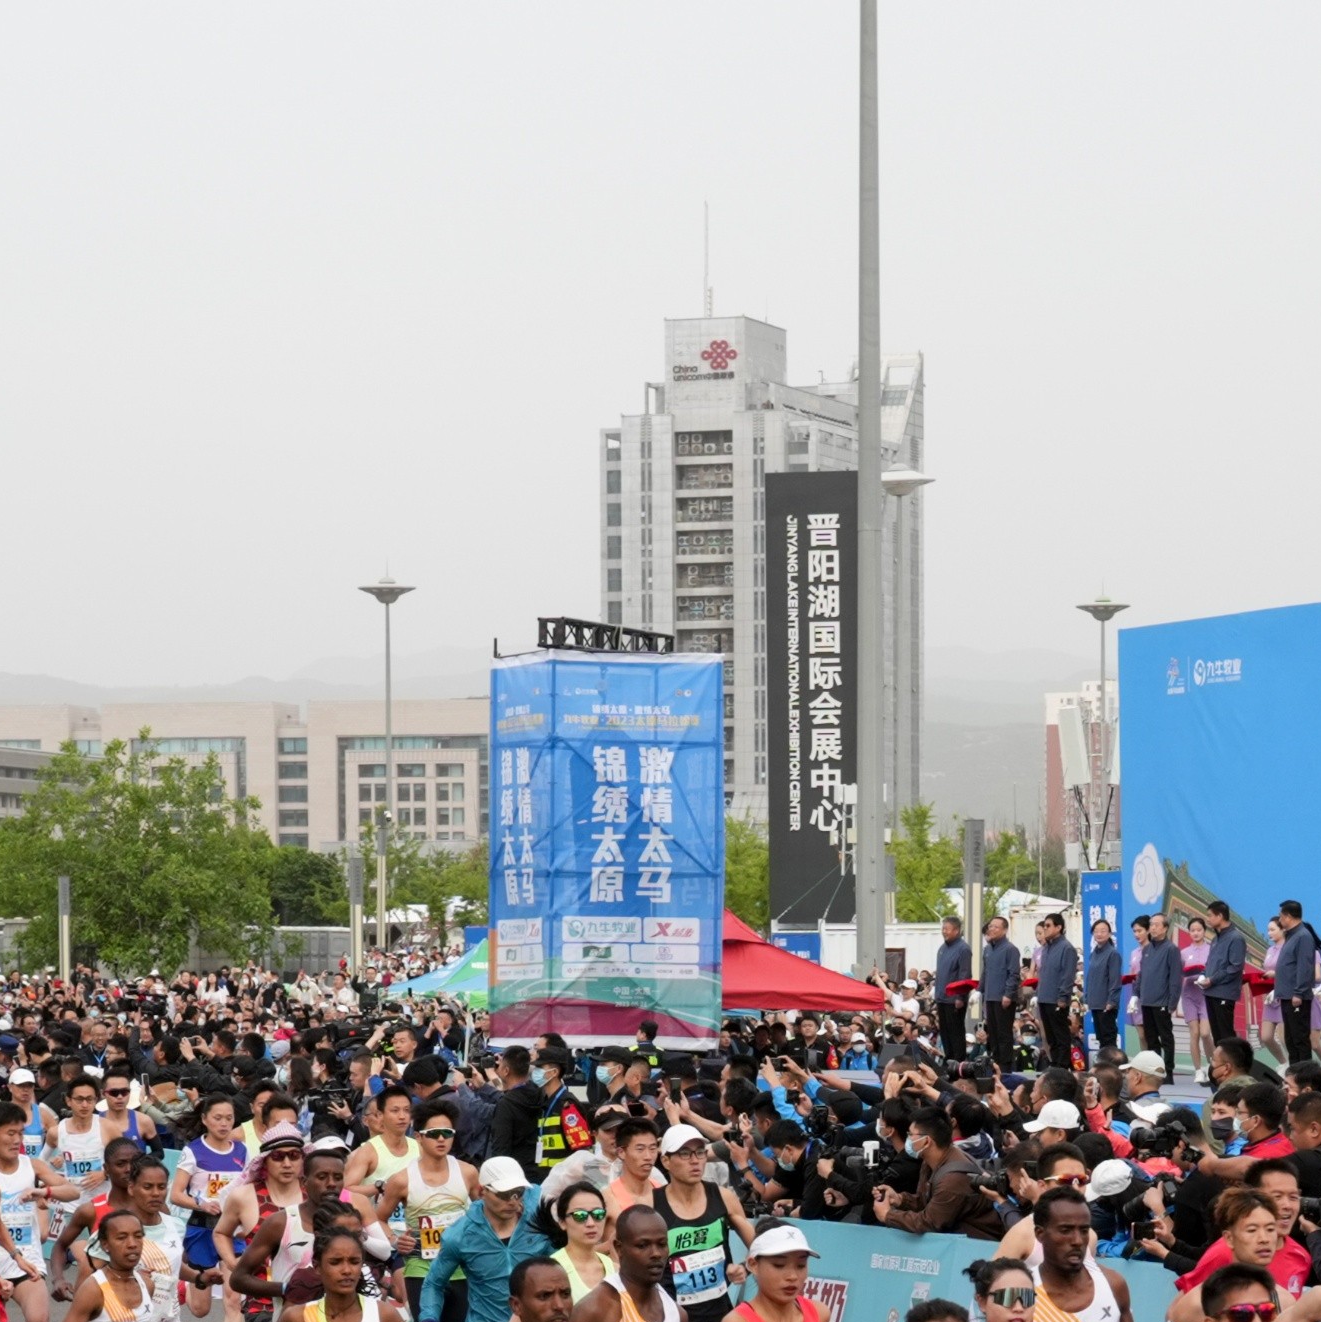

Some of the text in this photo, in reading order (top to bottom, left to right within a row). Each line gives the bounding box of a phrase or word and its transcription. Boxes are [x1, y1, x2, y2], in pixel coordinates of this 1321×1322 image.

[673, 365, 698, 373] China
[807, 513, 842, 832] 晋阳湖国际会展中心
[589, 745, 629, 903] 锦绣太原
[635, 746, 675, 904] 激情太马
[587, 921, 637, 934] 九牛牧业
[72, 1162, 92, 1174] 102
[674, 1227, 708, 1250] 怡寶
[688, 1267, 717, 1288] 113
